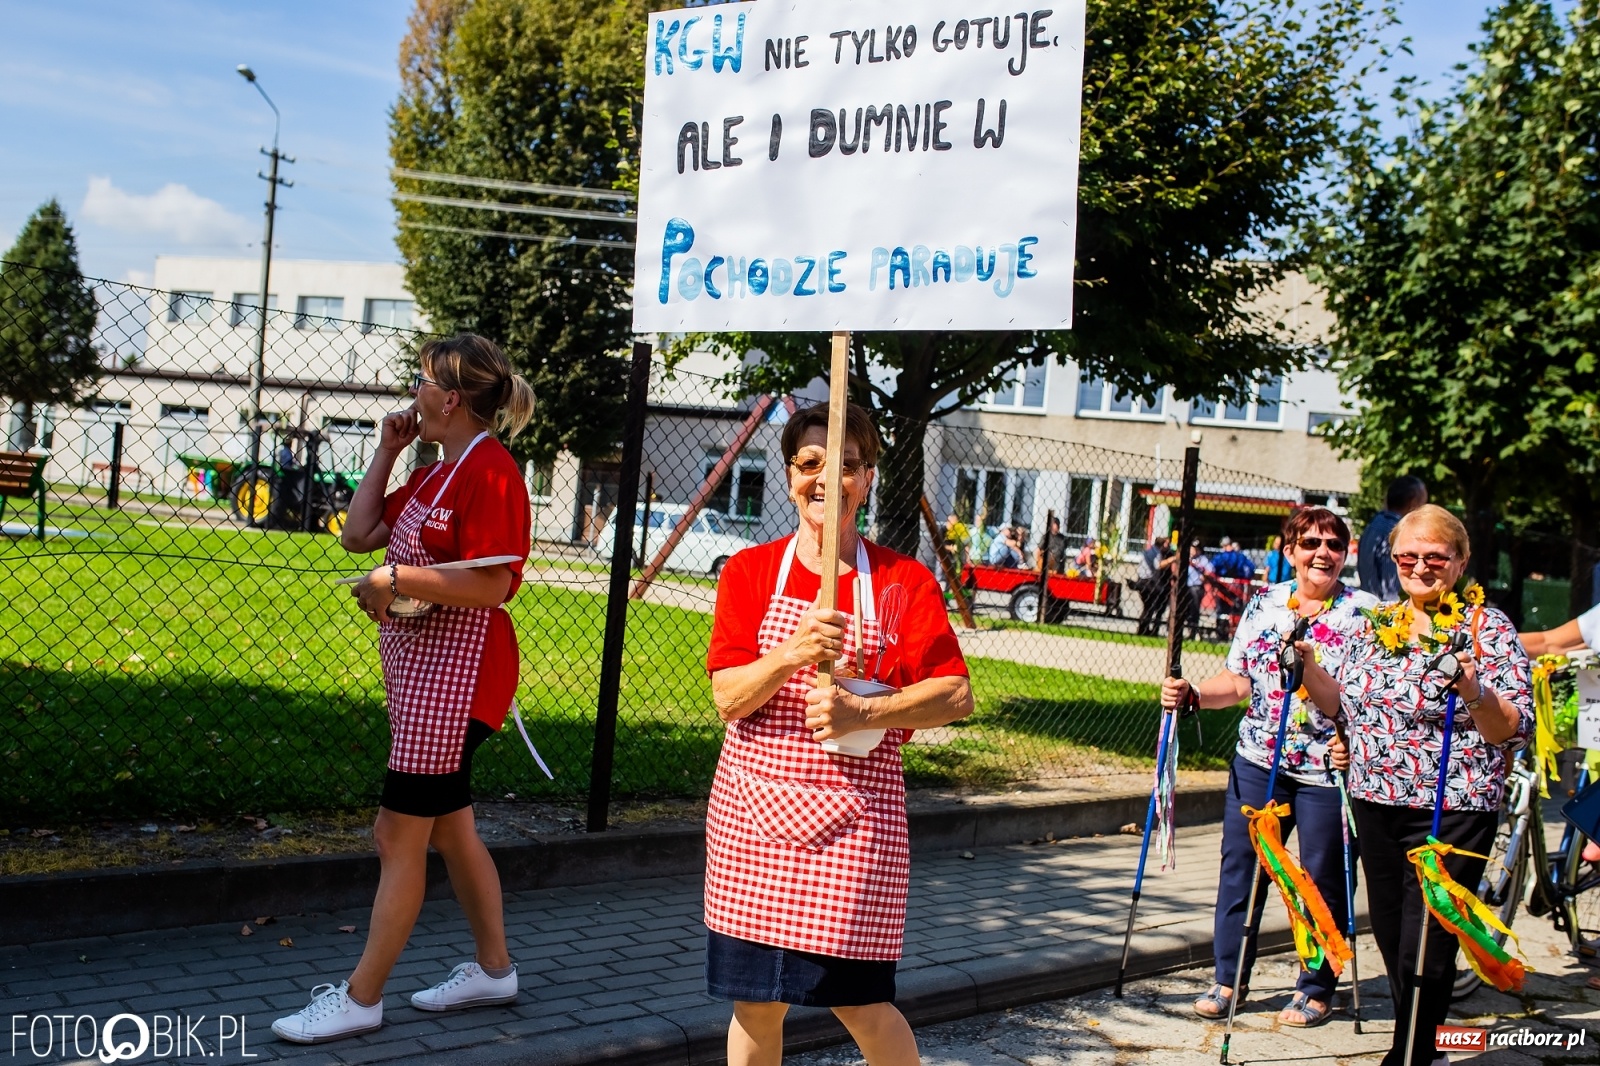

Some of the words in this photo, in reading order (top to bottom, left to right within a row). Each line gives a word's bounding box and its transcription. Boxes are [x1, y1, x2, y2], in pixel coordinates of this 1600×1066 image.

[654, 12, 746, 77] KGW
[765, 35, 810, 72] NIE
[829, 24, 918, 65] TYLKO
[677, 115, 744, 175] ALE
[768, 113, 783, 162] I
[808, 99, 953, 158] DUMNIE
[973, 98, 1007, 149] W
[658, 216, 848, 305] POCHODZIE
[869, 236, 1039, 299] PARADUJE
[425, 519, 448, 531] RUCIN
